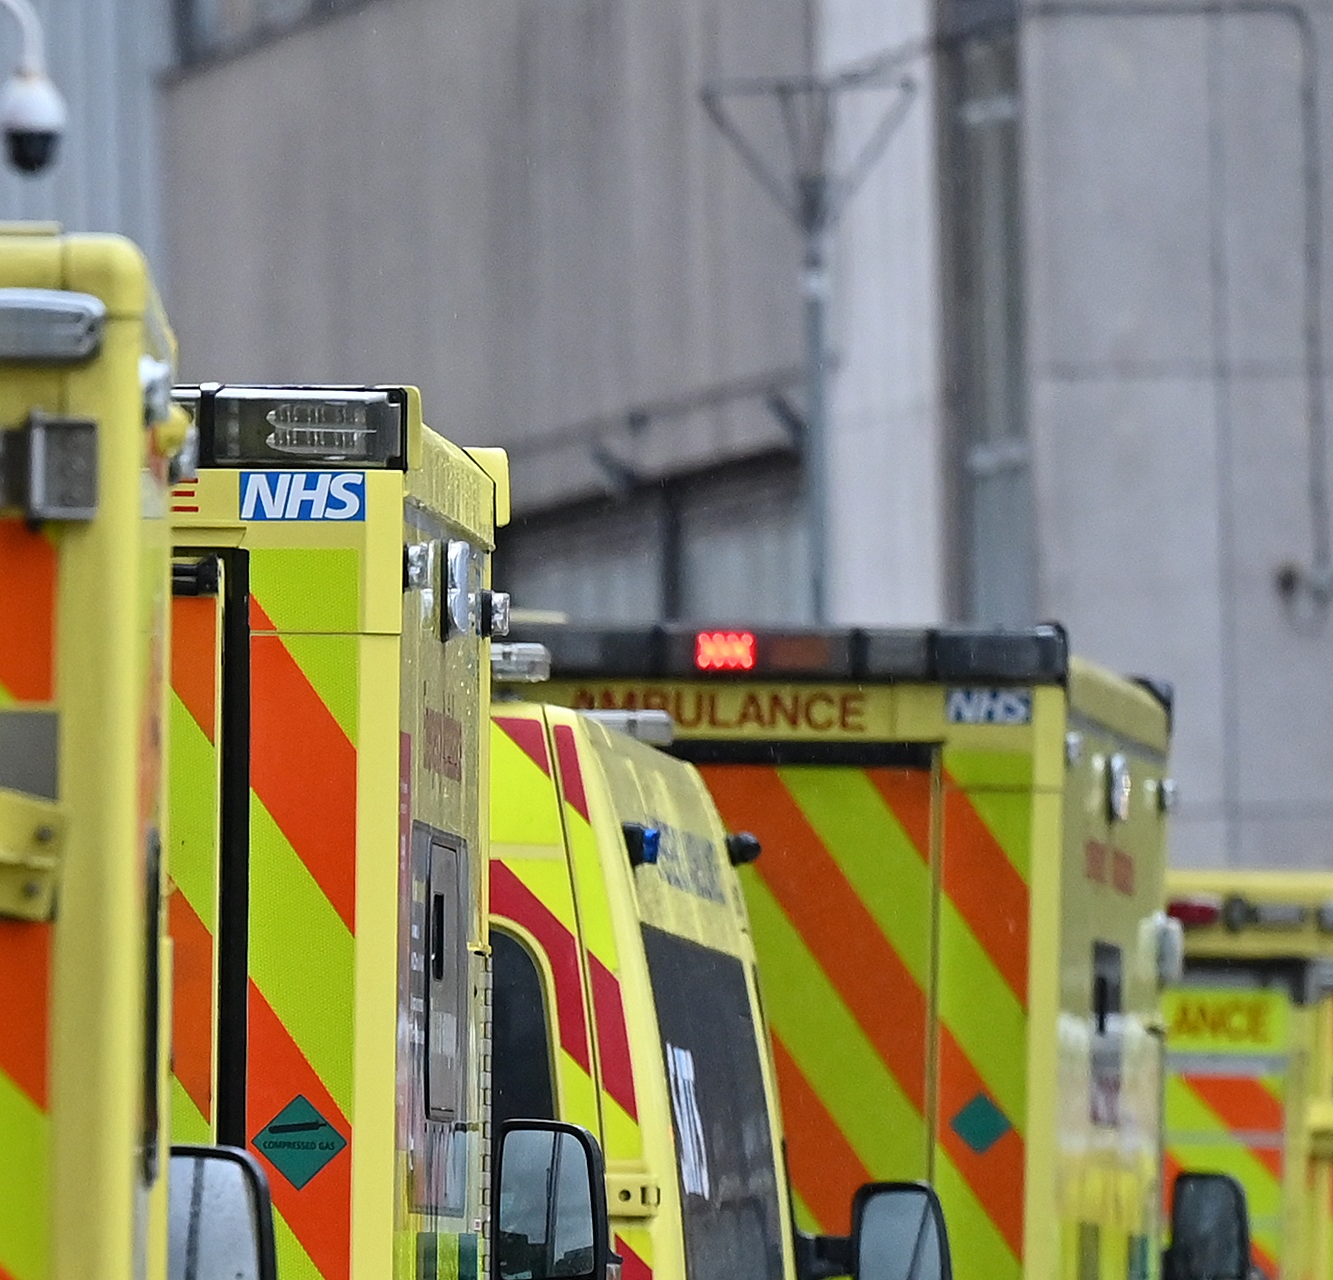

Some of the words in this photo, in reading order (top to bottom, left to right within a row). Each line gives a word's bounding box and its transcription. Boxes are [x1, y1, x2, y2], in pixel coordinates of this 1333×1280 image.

[240, 473, 364, 519] NHS
[947, 687, 1028, 724] NHS
[262, 1140, 317, 1151] COMPRESSED
[318, 1141, 336, 1151] GAS
